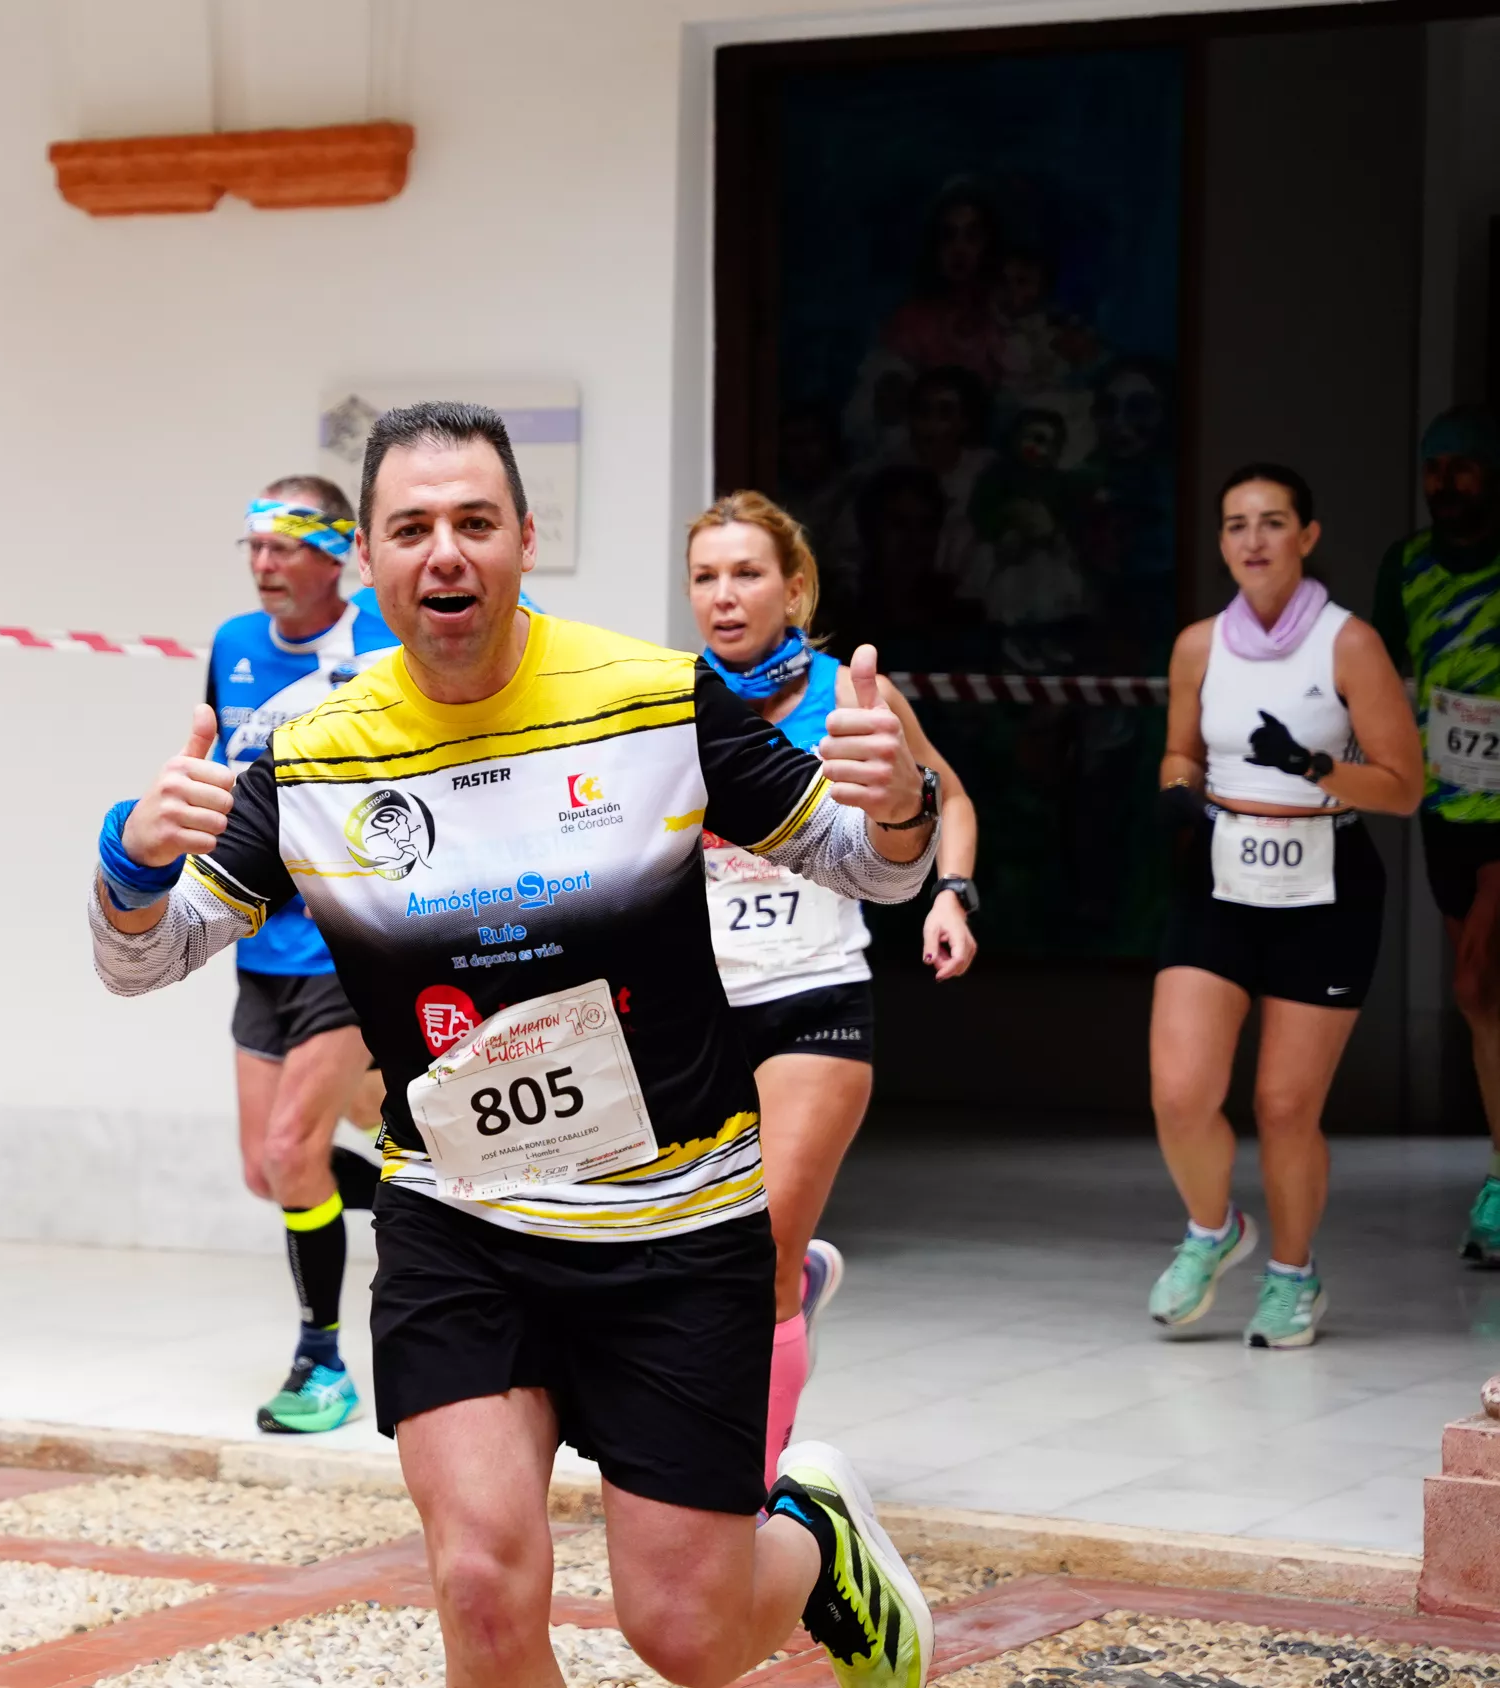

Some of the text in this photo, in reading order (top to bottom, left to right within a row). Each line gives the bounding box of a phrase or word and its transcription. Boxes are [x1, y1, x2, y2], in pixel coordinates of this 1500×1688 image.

[1447, 726, 1499, 760] 672
[452, 767, 511, 790] FASTER
[357, 790, 391, 819] ATLETISMO
[558, 802, 621, 822] Diputación
[561, 814, 624, 834] de Córdoba
[1241, 838, 1303, 866] 800
[385, 866, 408, 880] RUTE
[406, 870, 591, 917] Atmósfera Sport
[727, 891, 800, 931] 257
[478, 923, 527, 945] Rute
[451, 942, 564, 969] El deporte es vida
[486, 1036, 554, 1065] LUCENA
[470, 1066, 584, 1136] 805
[481, 1125, 600, 1162] JOSÉ MARÍA ROMERO CABALLERO
